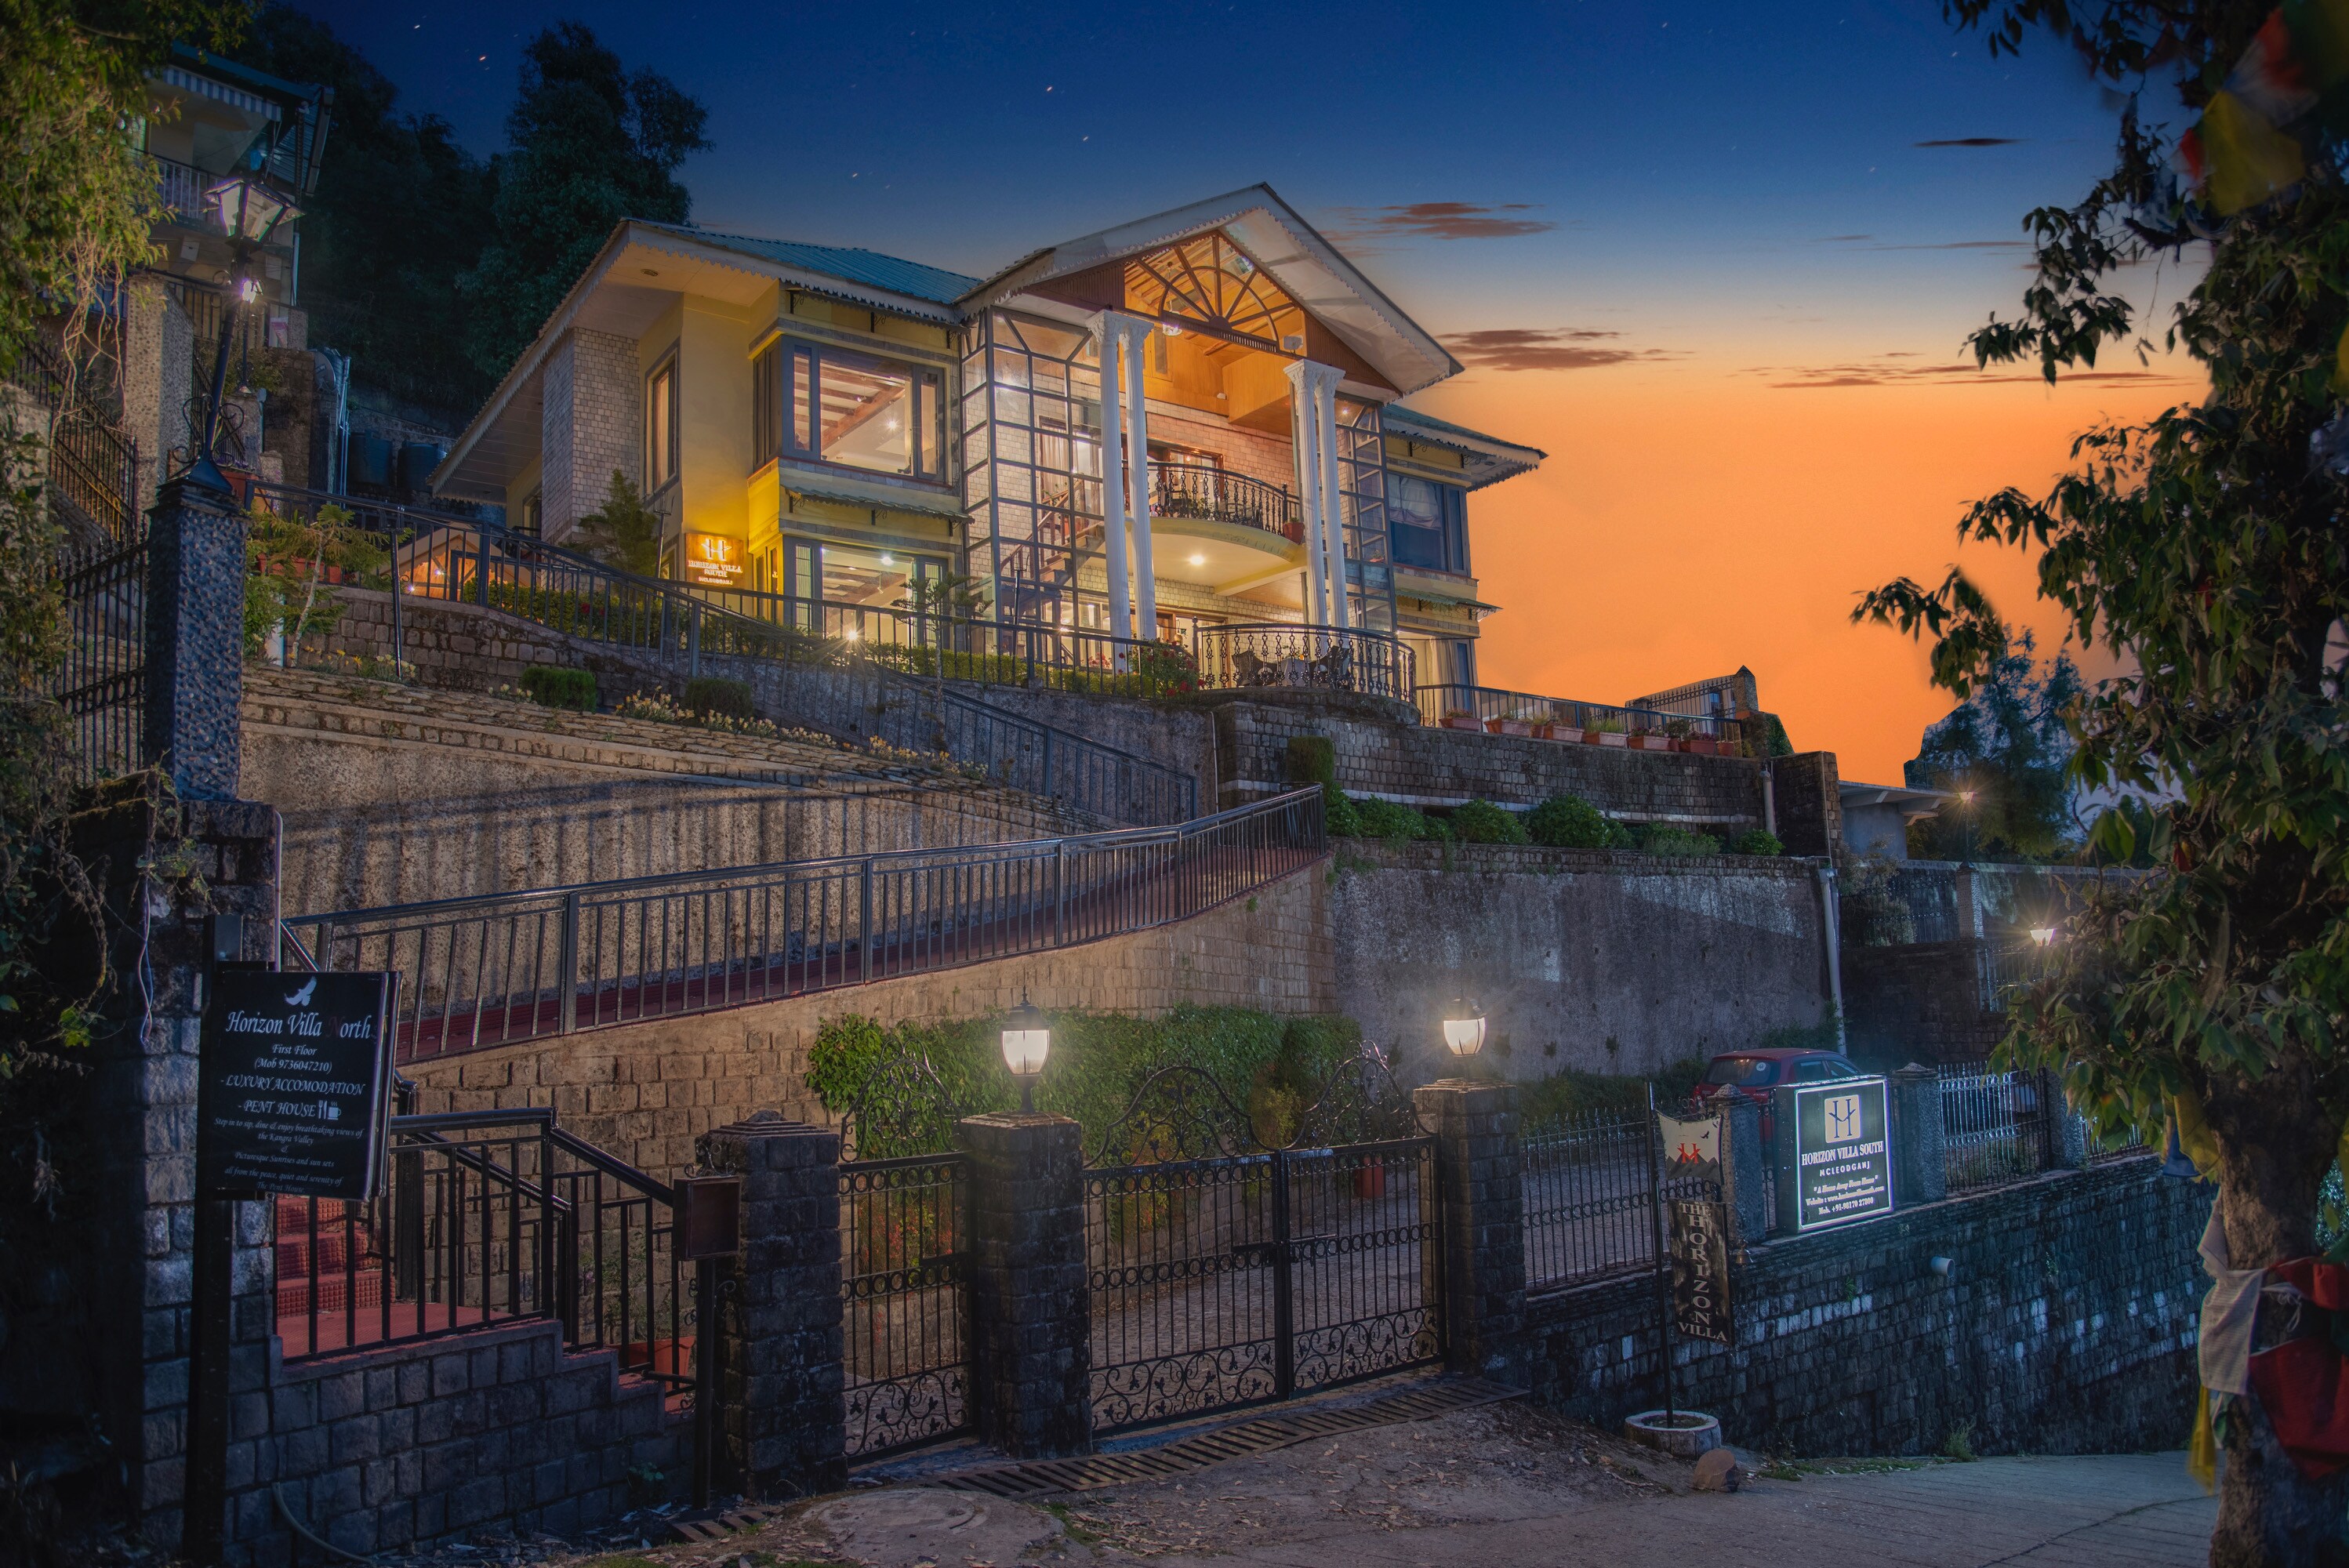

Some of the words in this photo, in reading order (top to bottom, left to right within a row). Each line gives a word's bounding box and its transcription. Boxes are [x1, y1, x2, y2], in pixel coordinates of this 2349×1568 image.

[226, 1010, 283, 1035] Horizon
[288, 1012, 322, 1036] Villa
[272, 1044, 292, 1054] First
[294, 1044, 318, 1056] Floor
[253, 1057, 278, 1070] (Mob
[226, 1075, 274, 1091] LUXURY
[273, 1077, 365, 1095] ACCOMODATION
[243, 1099, 276, 1113] PENT
[276, 1101, 317, 1117] HOUSE
[214, 1118, 228, 1128] Step
[255, 1120, 269, 1129] dine
[278, 1123, 294, 1134] enjoy
[295, 1123, 335, 1137] breathtaking
[336, 1127, 354, 1136] views
[355, 1128, 365, 1139] of
[268, 1133, 292, 1145] Kangra
[293, 1134, 314, 1146] Valley
[234, 1151, 269, 1163] Picturesque
[269, 1155, 296, 1164] Sunrises
[1802, 1149, 1835, 1166] HORIZON
[1837, 1145, 1859, 1160] VILLA
[1859, 1141, 1883, 1156] SOUTH
[224, 1166, 233, 1174] all
[232, 1167, 248, 1178] from
[249, 1168, 259, 1177] the
[278, 1173, 295, 1182] quiet
[308, 1175, 335, 1185] serenity
[334, 1176, 343, 1187] of
[1820, 1161, 1870, 1177] MCLEODGANJ
[1679, 1203, 1712, 1217] THE
[1689, 1215, 1711, 1325] HORIZON
[1678, 1322, 1727, 1341] VILLA
